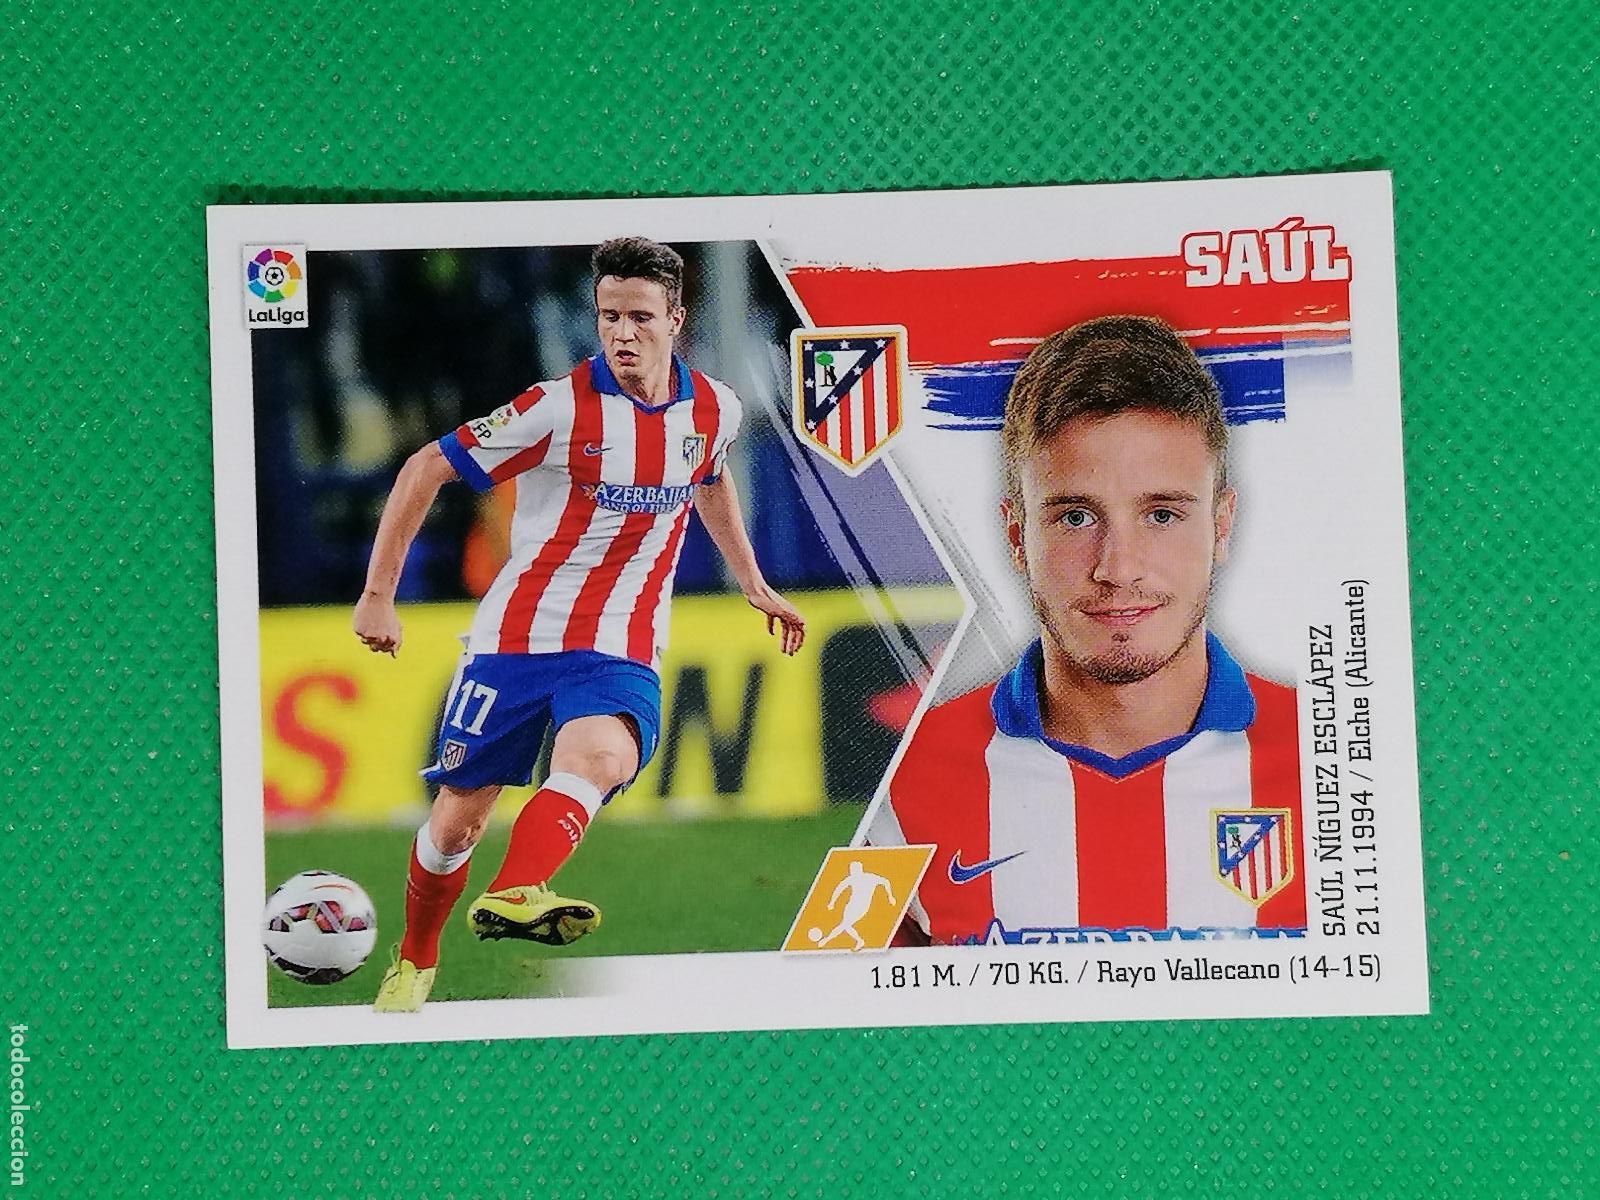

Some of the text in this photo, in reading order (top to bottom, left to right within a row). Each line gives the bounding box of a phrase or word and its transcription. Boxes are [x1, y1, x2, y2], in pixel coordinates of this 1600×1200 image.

[1180, 216, 1352, 288] SAÚL
[1340, 579, 1375, 688] (Alicante)
[449, 679, 498, 737] 17
[1346, 697, 1372, 762] Elche
[1305, 624, 1346, 937] SAÚL ÑÍGUEZ ESCLÁPEZ
[1350, 790, 1380, 936] 21.11.1994
[871, 964, 921, 989] 1.81
[931, 964, 961, 987] M.
[989, 962, 1020, 986] 70
[1028, 961, 1069, 985] KG.
[1096, 960, 1156, 988] Rayo
[1163, 957, 1280, 981] Vallecano
[1289, 953, 1381, 985] (14-15)
